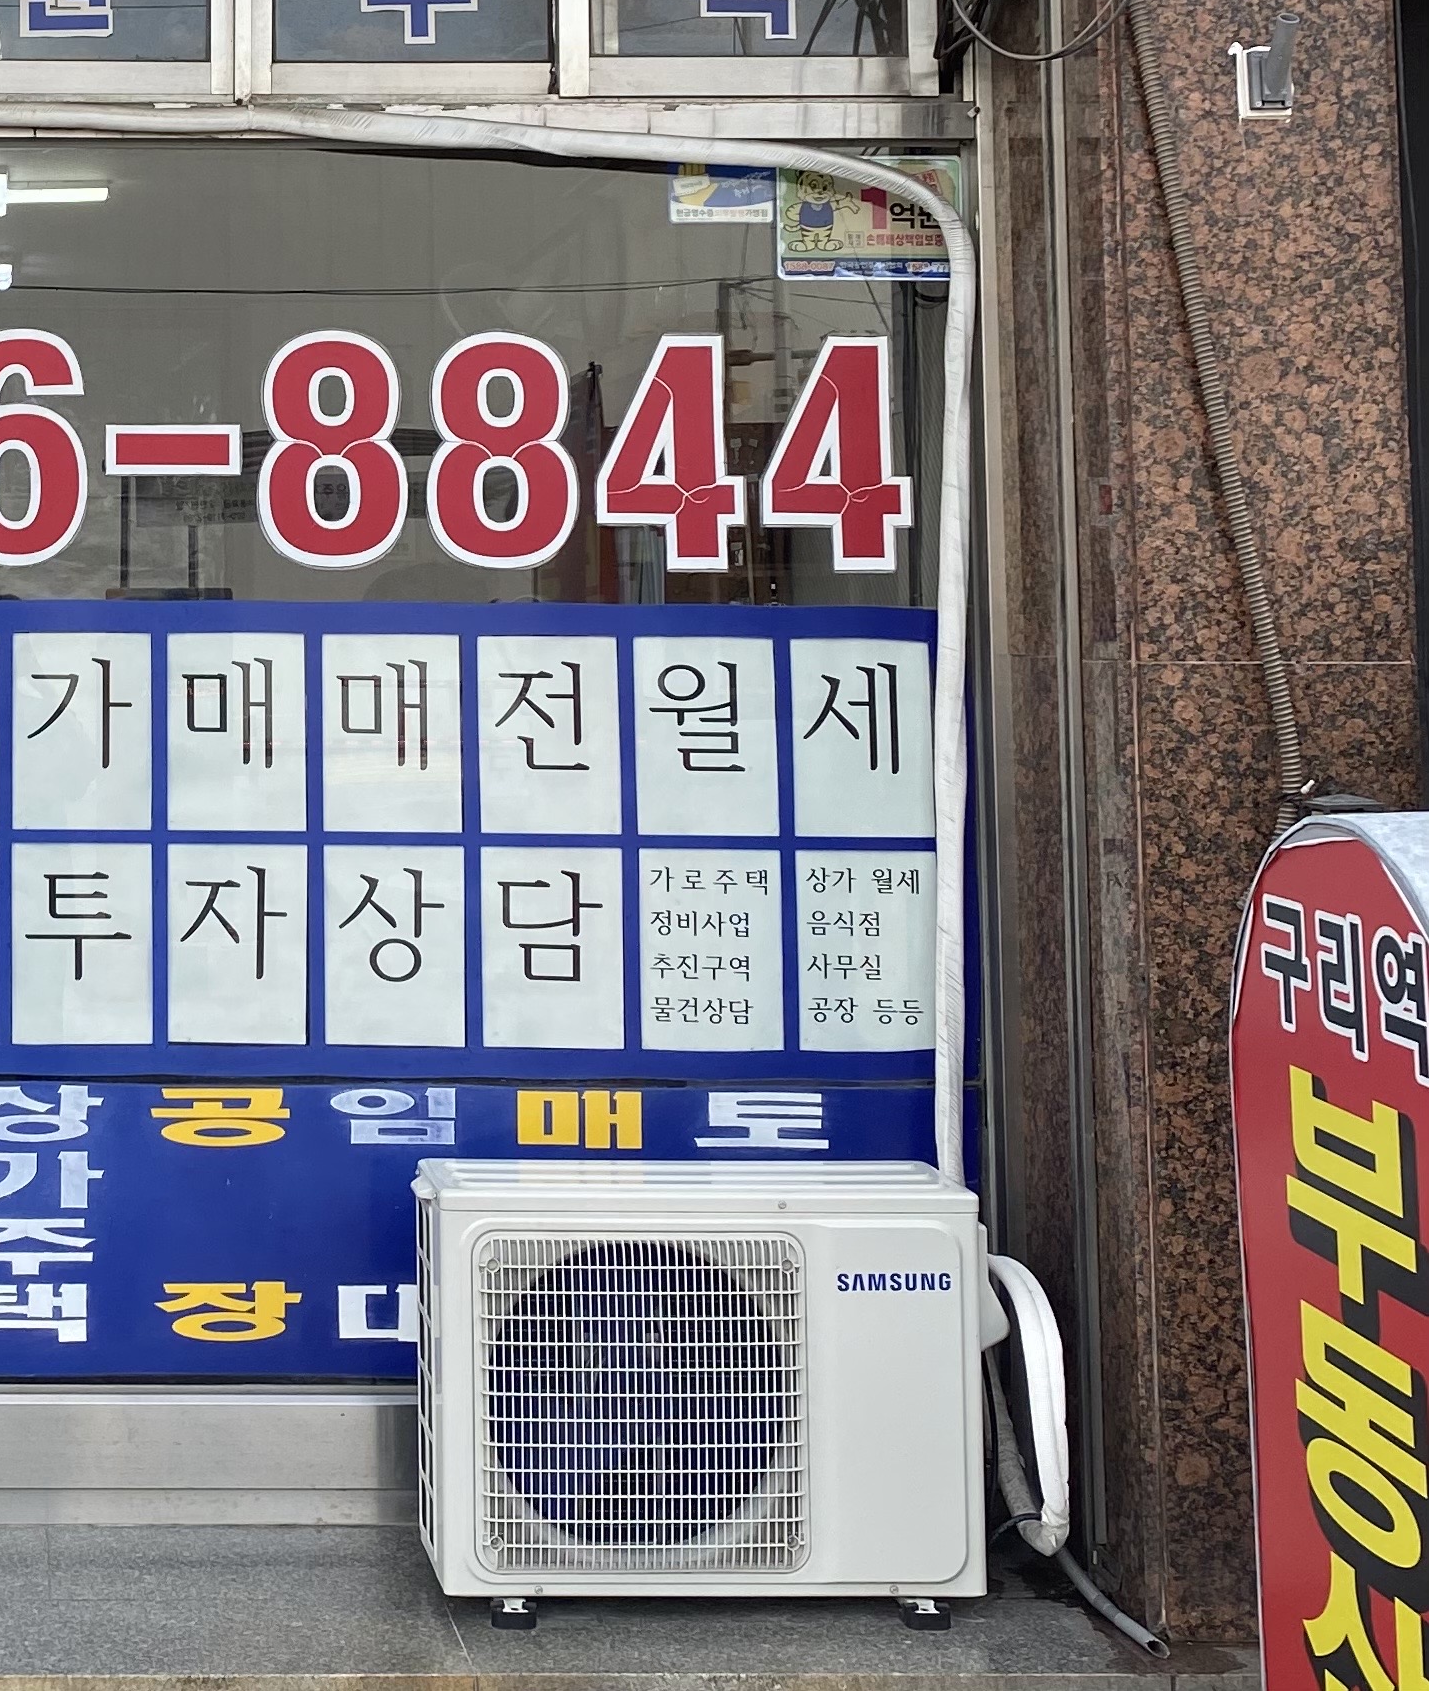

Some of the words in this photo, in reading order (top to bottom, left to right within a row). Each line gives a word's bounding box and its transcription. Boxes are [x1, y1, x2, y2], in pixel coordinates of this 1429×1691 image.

[805, 866, 857, 894] 상가
[870, 867, 920, 895] 월세
[650, 909, 750, 938] 정비사업
[805, 910, 880, 937] 음식점
[649, 952, 750, 983] 추진구역
[806, 952, 883, 981] 사무실
[1261, 893, 1429, 1088] 구리역
[649, 996, 755, 1025] 물건상담
[807, 996, 859, 1024] 공장
[872, 998, 925, 1026] 등등
[836, 1272, 953, 1292] SAMSUNG
